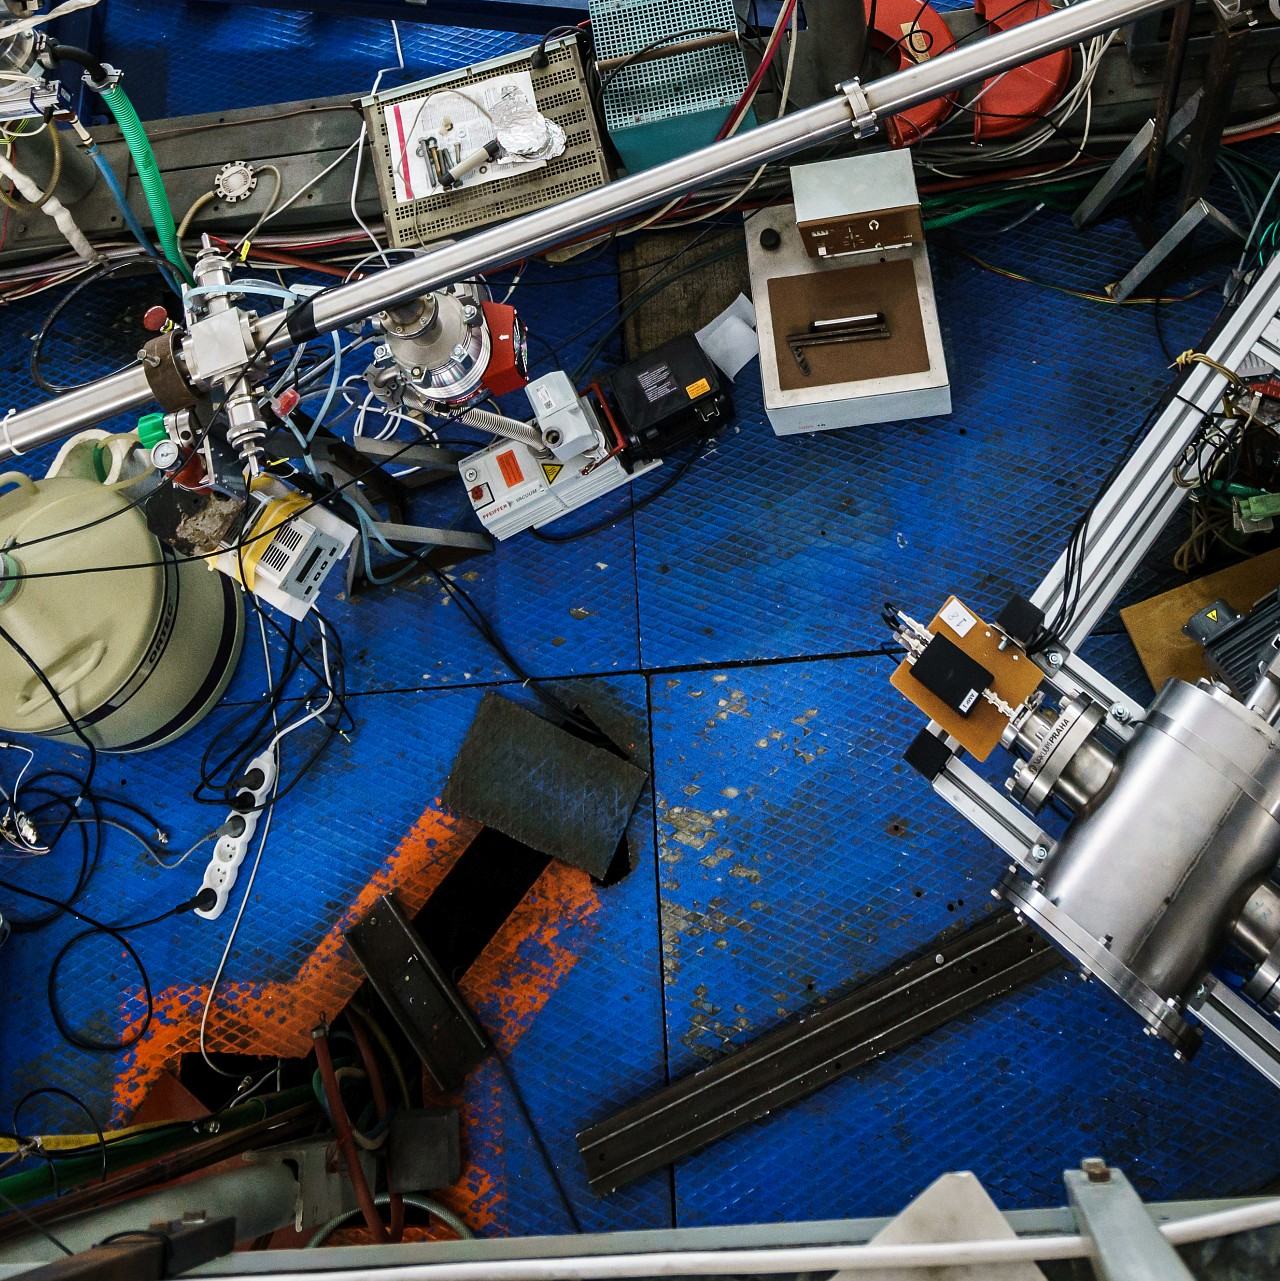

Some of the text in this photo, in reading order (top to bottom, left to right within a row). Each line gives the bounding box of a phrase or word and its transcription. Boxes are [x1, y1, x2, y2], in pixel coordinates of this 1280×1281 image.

[482, 488, 538, 520] PFEIFFER VACUUM
[149, 603, 174, 664] ORTEC
[1050, 717, 1070, 744] PRAHA
